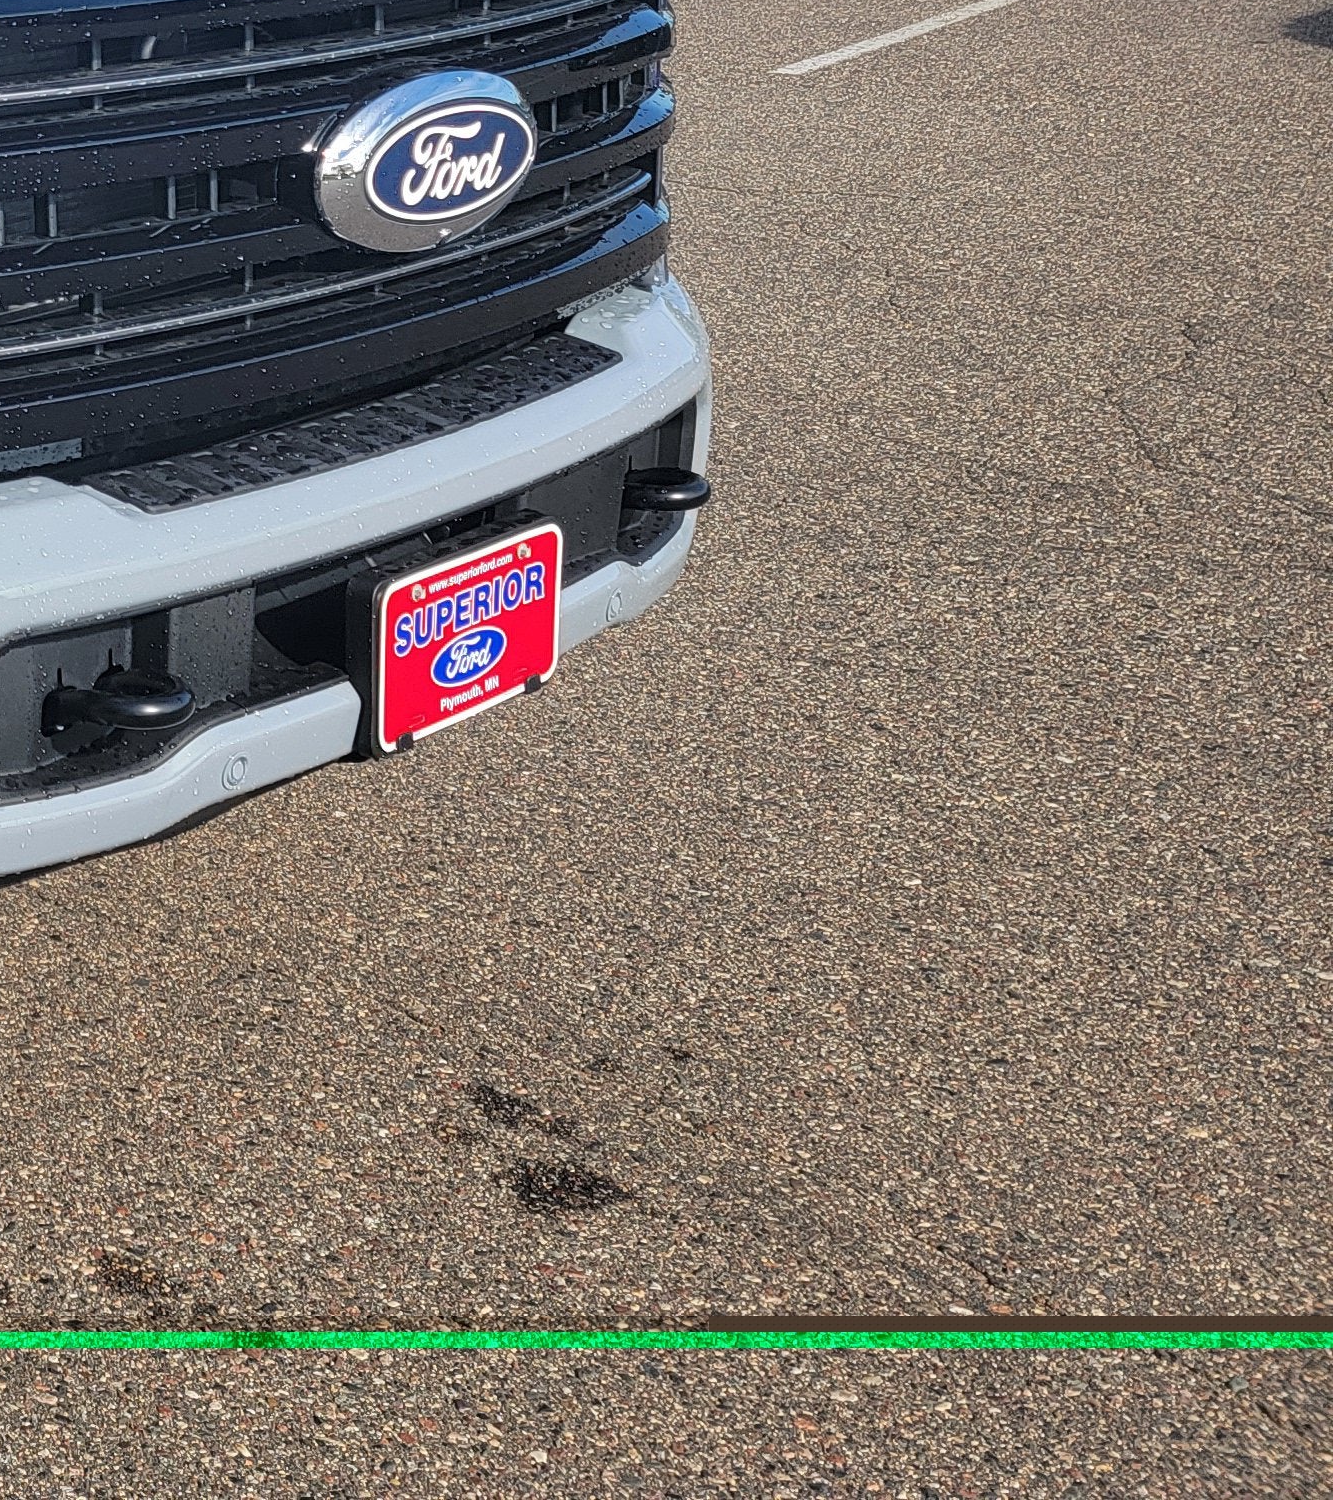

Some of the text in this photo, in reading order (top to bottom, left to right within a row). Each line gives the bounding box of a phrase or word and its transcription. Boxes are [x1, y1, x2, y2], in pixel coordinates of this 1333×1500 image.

[400, 120, 506, 207] Ford
[428, 553, 513, 594] www.superiorford.com
[393, 561, 546, 658] SUPERIOR
[445, 634, 493, 680] Ford
[439, 675, 500, 713] Plymouth, MN
